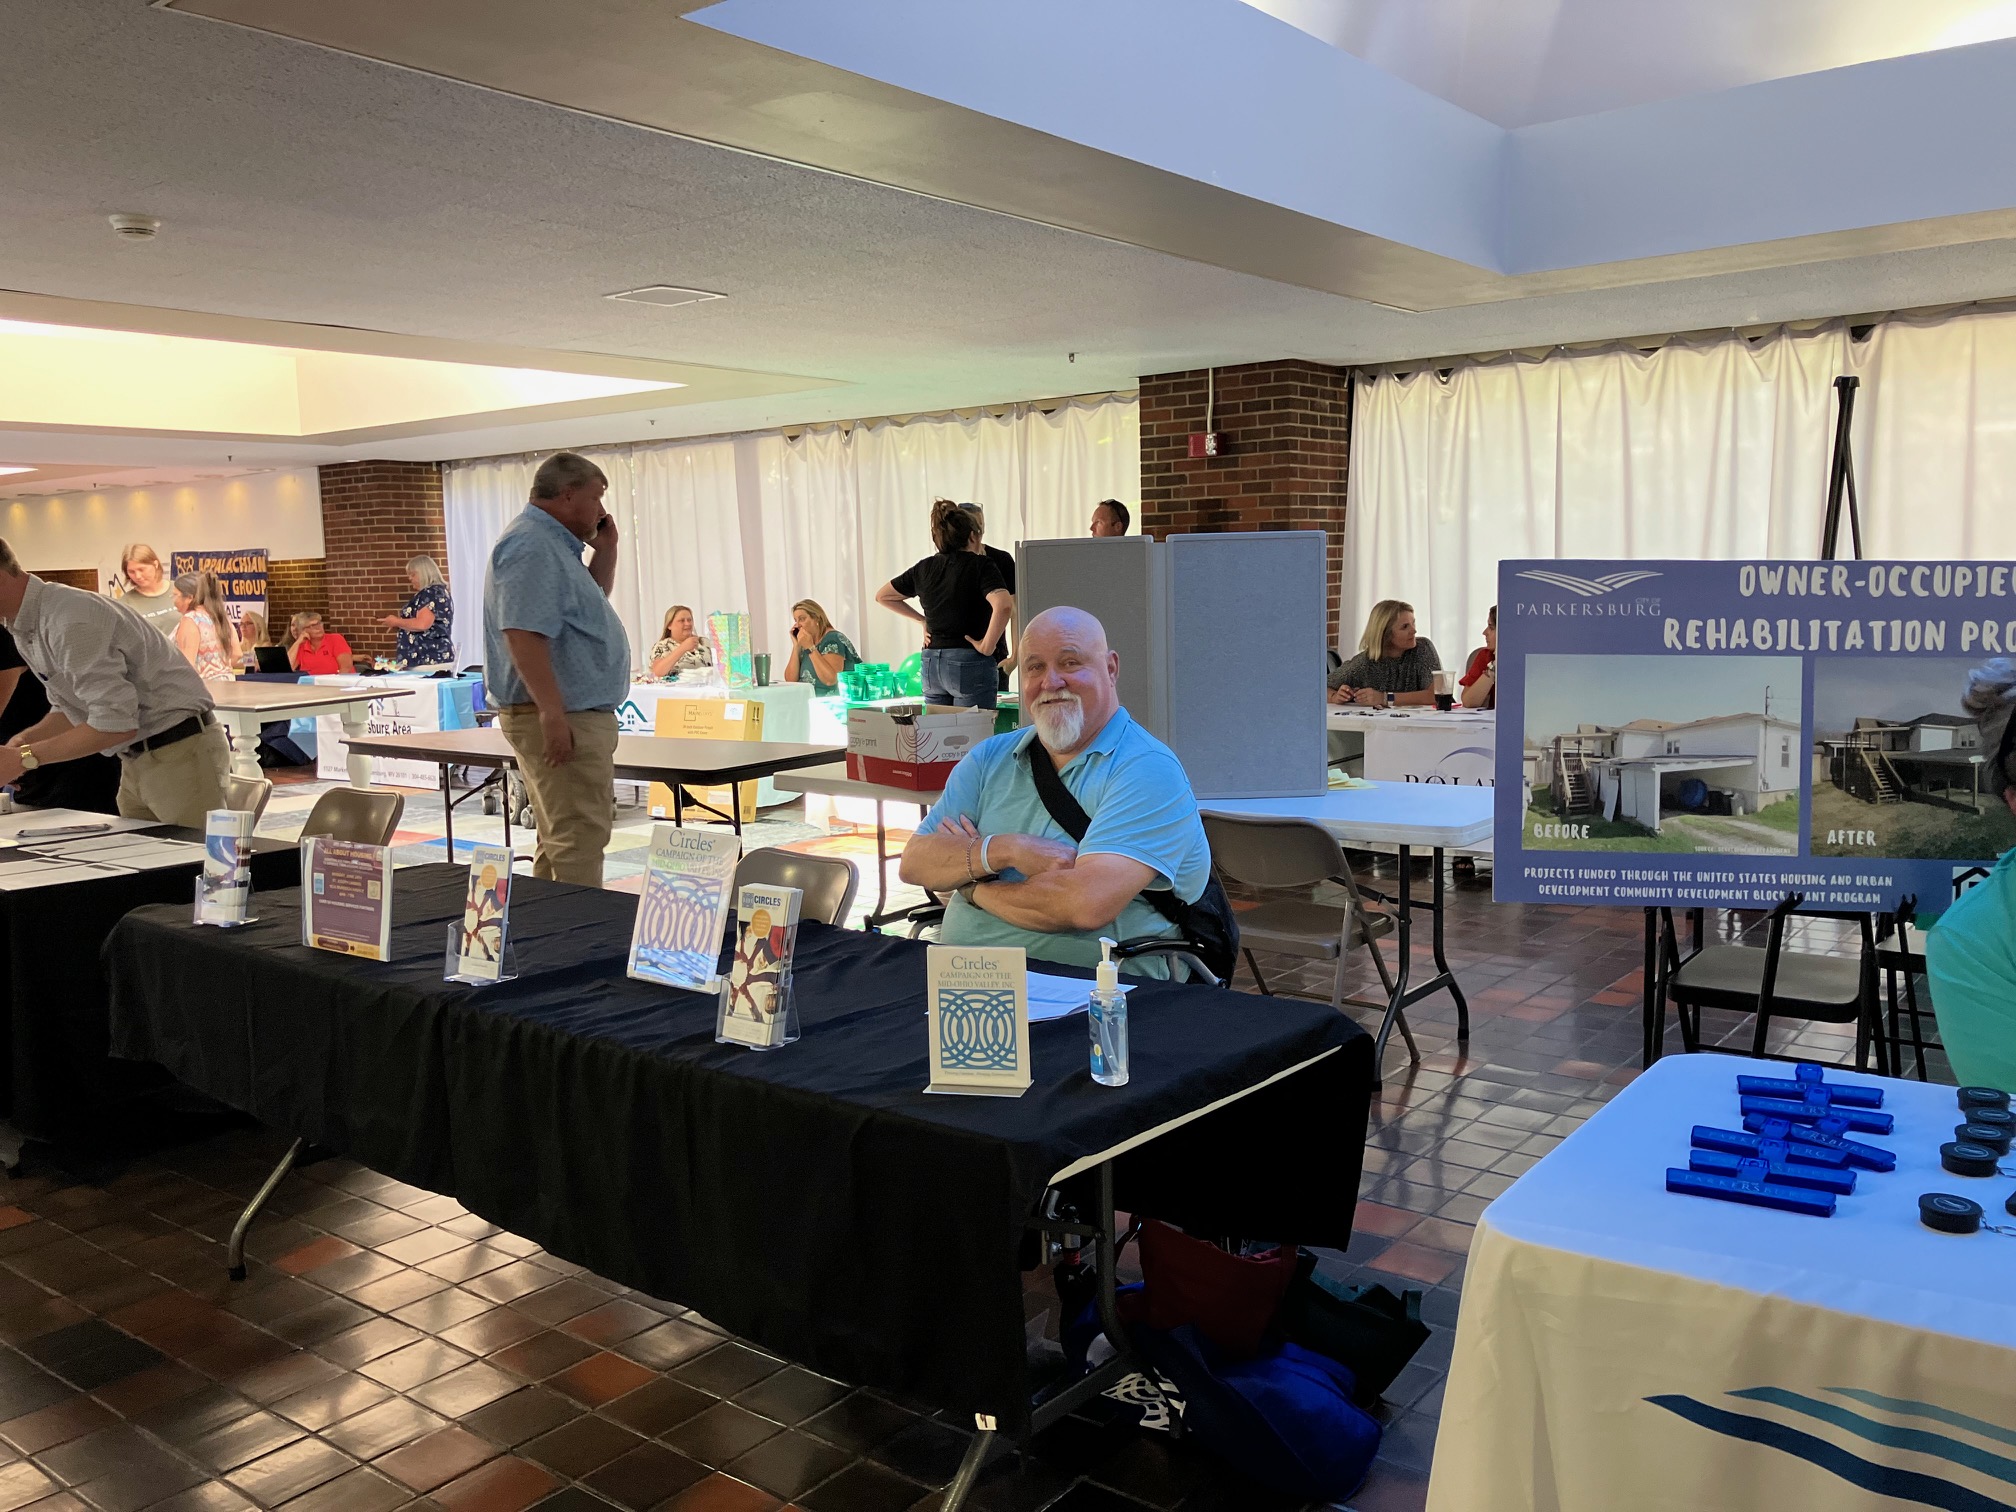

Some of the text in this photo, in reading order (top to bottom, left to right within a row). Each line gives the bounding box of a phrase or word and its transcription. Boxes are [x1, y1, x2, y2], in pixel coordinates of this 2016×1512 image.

[198, 556, 267, 573] APPALACHIAN
[232, 579, 267, 596] GROUP
[1739, 564, 2016, 598] OWNER-OCCUPIE
[225, 604, 242, 620] ALE
[1516, 603, 1661, 616] PARKERSBURG
[1663, 617, 1946, 652] REHABILITATION
[392, 721, 412, 735] Area
[941, 751, 956, 759] copy
[1533, 823, 1591, 840] BEFORE
[1827, 829, 1877, 847] AFTER
[669, 830, 713, 851] Circles
[656, 848, 695, 861] CAMPAIGN
[1524, 867, 1893, 887] PROJECTS FUNDED THROUGH THE UNITED STATES HOUSING AND URBAN
[754, 895, 781, 907] CIRCLES
[1538, 884, 1880, 904] DEVELOPMENT COMMUNITY DEVELOPMENT BLOCK ANT PROGRAM
[951, 956, 998, 970] Circles
[938, 980, 974, 988] MID-OHIO
